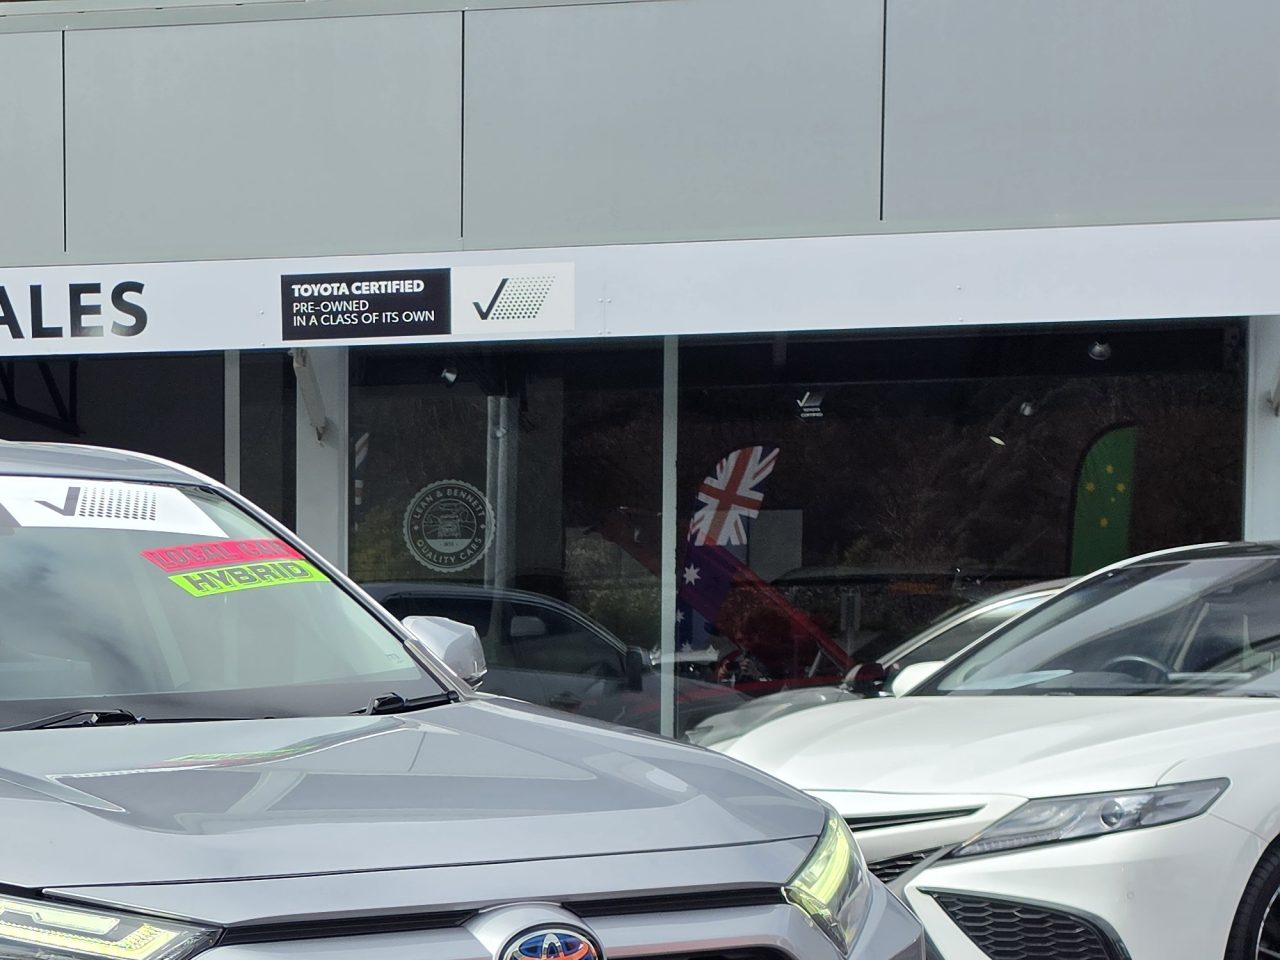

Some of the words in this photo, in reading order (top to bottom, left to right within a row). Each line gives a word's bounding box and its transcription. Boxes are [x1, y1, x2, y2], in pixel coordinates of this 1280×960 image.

[292, 282, 349, 297] TOYOTA
[351, 279, 425, 296] CERTIFIED
[293, 300, 369, 314] PRE-OWNED
[293, 314, 306, 327] IN
[309, 314, 318, 326] A
[320, 312, 358, 326] CLASS
[361, 312, 379, 324] OF
[382, 311, 399, 323] ITS
[402, 310, 435, 323] OWN
[153, 543, 233, 567] LOCAL
[183, 561, 313, 592] HYBRID
